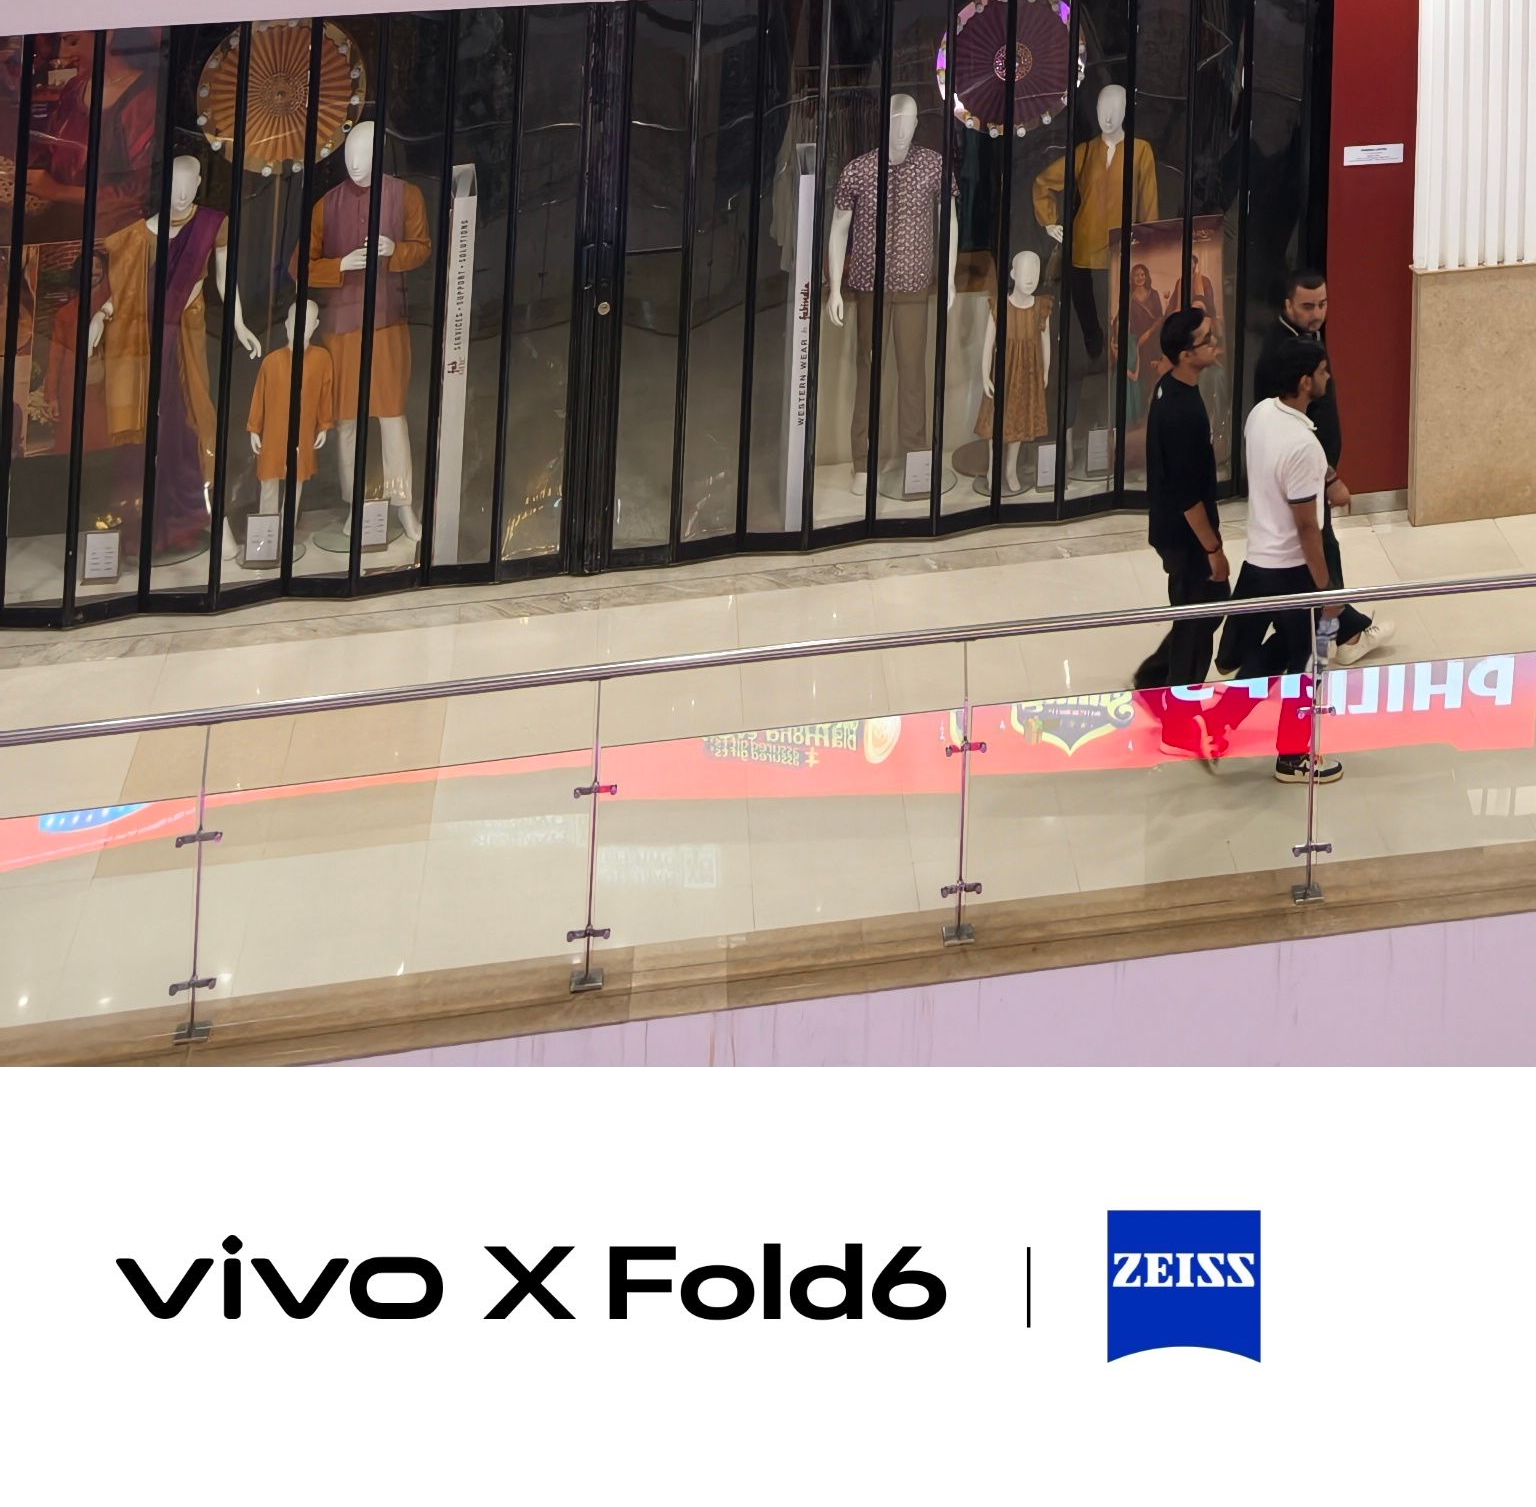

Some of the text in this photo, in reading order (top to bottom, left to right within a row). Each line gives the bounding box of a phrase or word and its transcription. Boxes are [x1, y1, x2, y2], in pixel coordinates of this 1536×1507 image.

[459, 220, 468, 262] SOLUTIONS
[456, 271, 465, 305] SUPPORT
[799, 282, 811, 321] fabindia
[800, 339, 808, 372] WEAR
[797, 375, 806, 426] WESTERN
